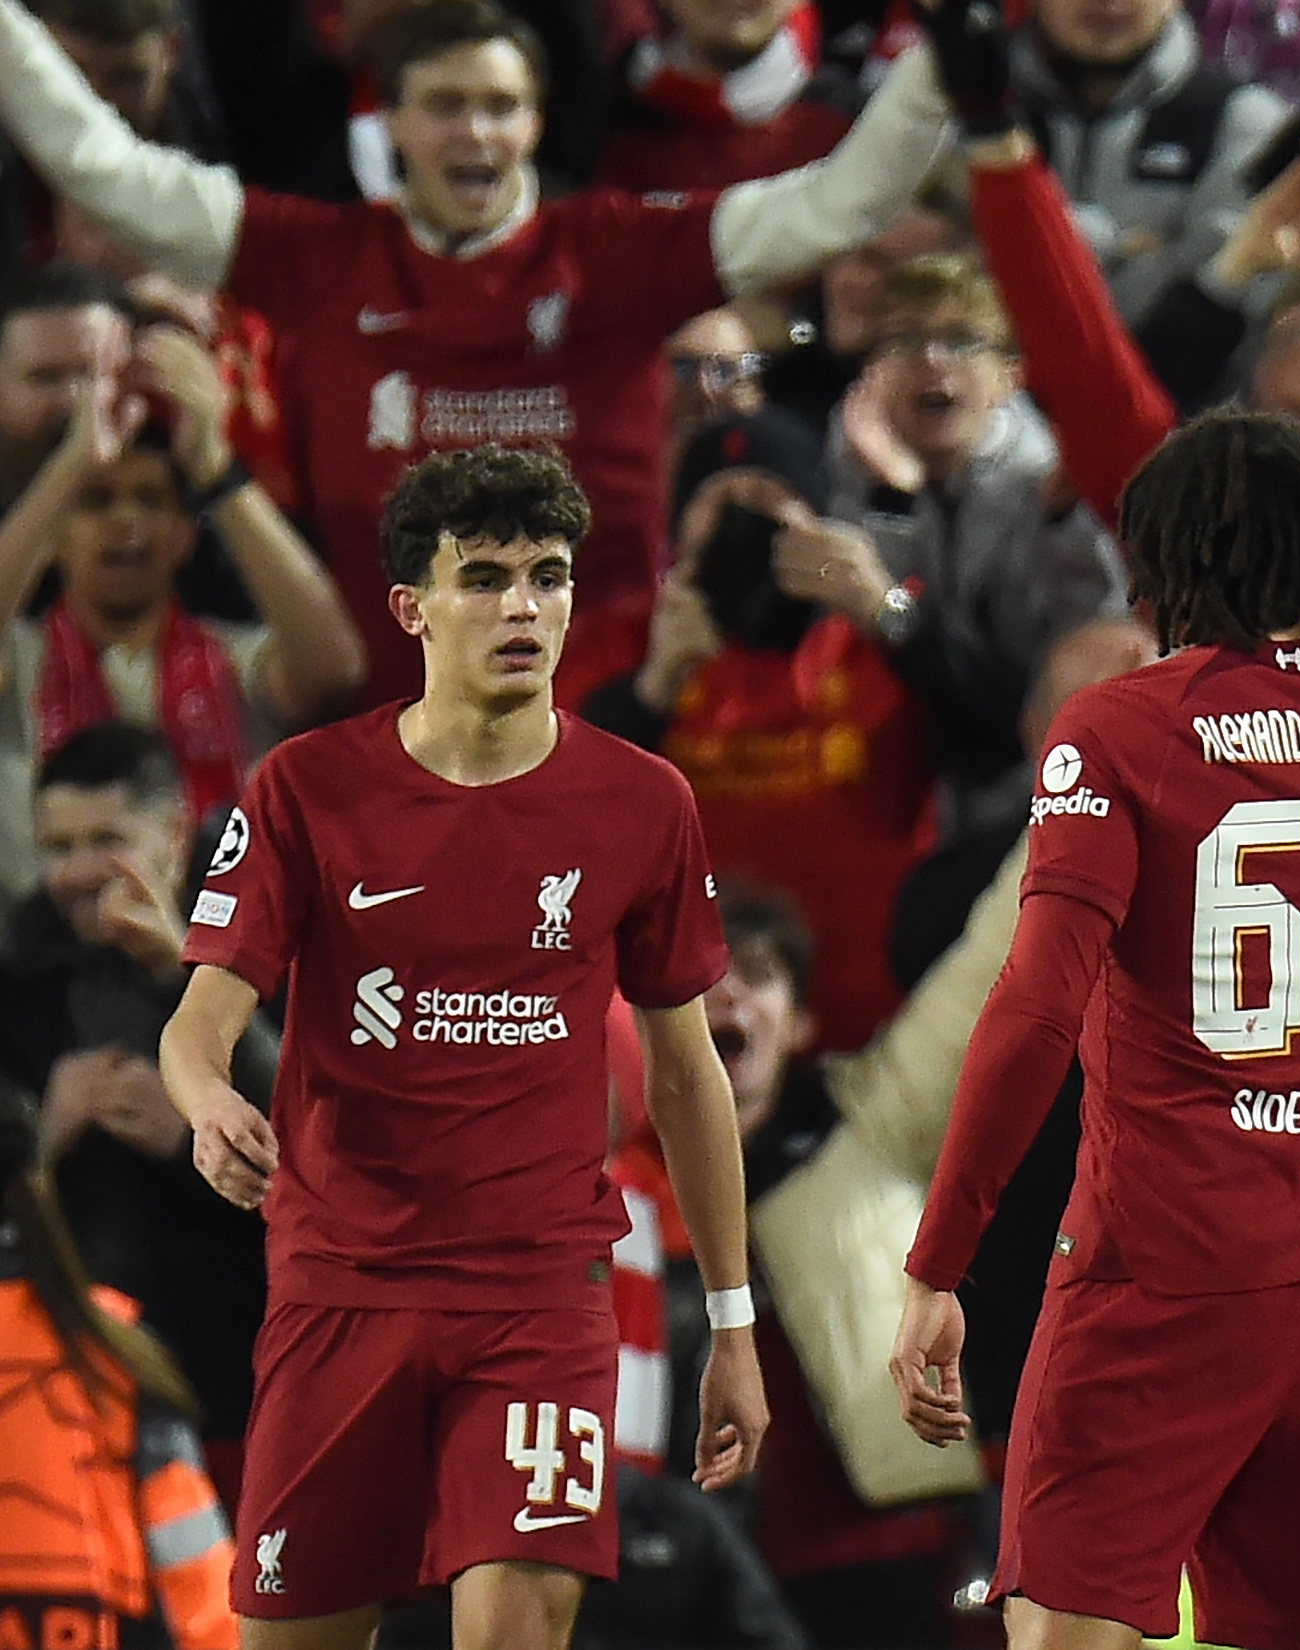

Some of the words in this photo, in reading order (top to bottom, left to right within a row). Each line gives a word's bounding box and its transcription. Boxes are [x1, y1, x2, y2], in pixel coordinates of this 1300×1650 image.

[1029, 787, 1110, 826] pedia
[531, 930, 572, 951] LFC
[412, 1012, 569, 1045] chartered
[505, 1402, 604, 1516] 43
[255, 1578, 286, 1594] LFC
